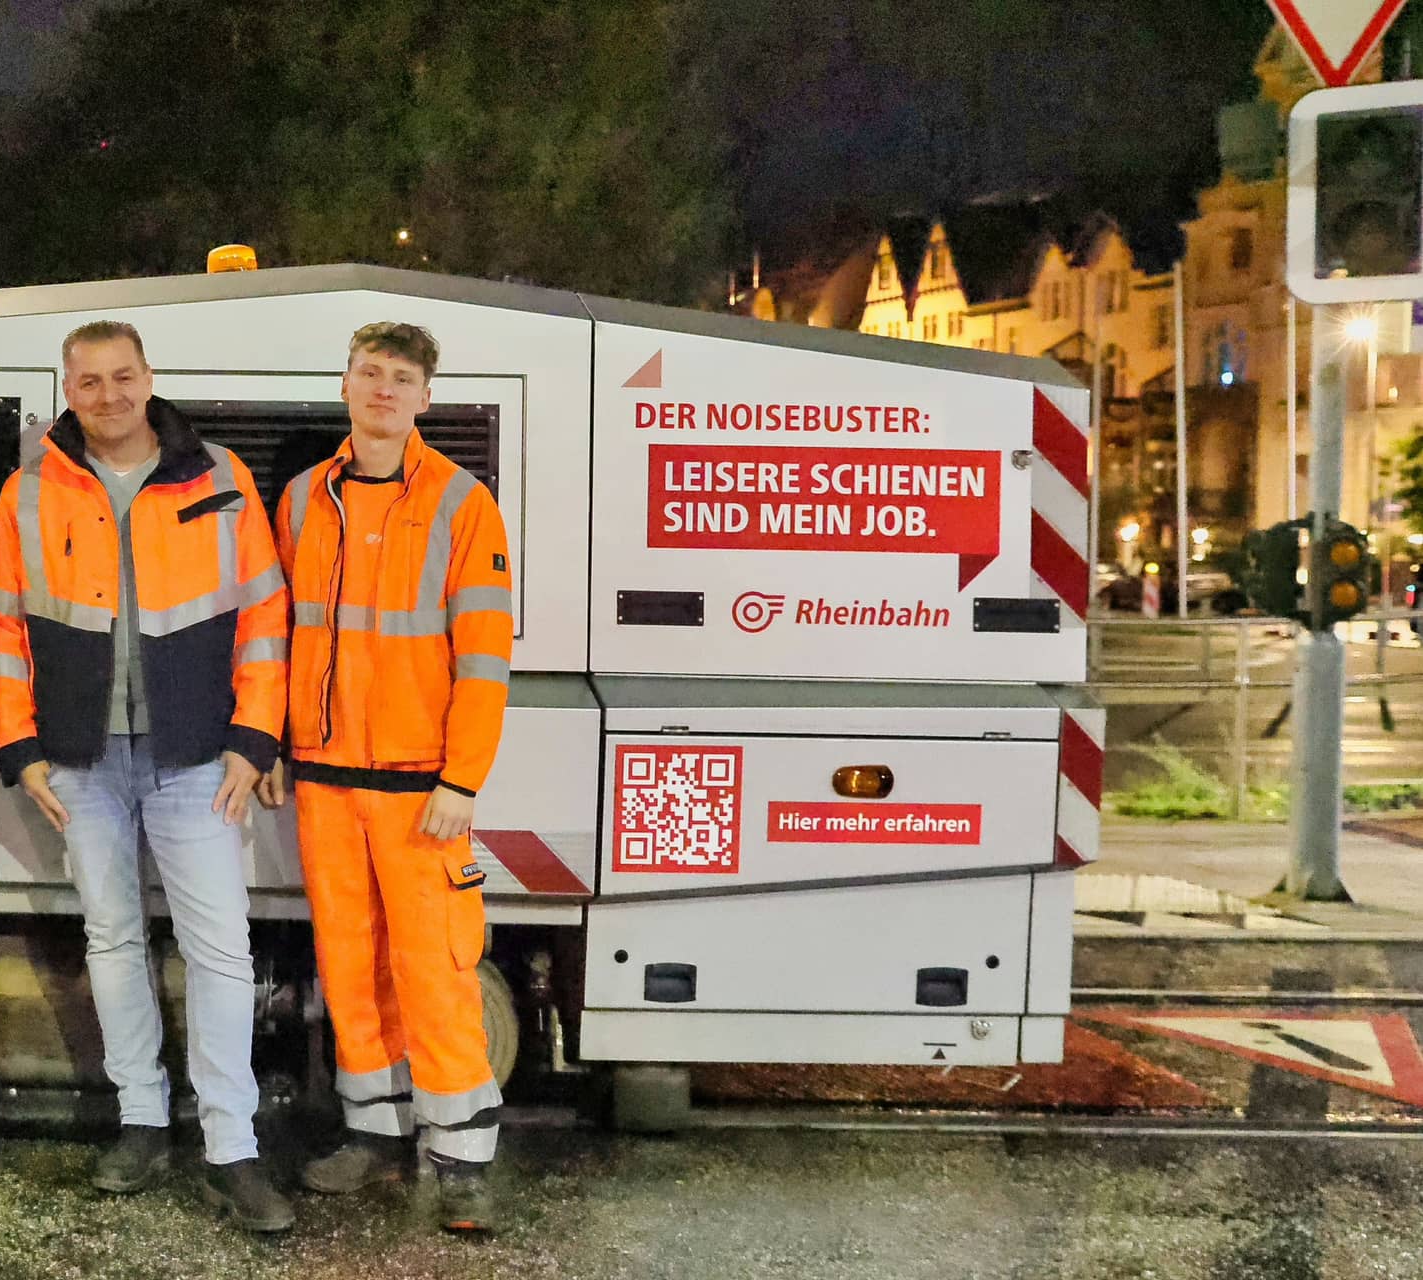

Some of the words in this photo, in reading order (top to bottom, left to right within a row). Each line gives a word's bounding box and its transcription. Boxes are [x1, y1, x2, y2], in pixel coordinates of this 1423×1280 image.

[635, 402, 697, 431] DER
[706, 403, 931, 434] NOISEBUSTER:
[664, 461, 800, 493] LEISERE
[810, 464, 986, 498] SCHIENEN
[663, 502, 749, 533] SIND
[760, 504, 852, 535] MEIN
[860, 505, 937, 537] JOB.
[795, 599, 950, 628] Rheinbahn
[778, 812, 821, 831] Hier
[825, 812, 880, 832] mehr
[884, 813, 971, 833] erfahren
